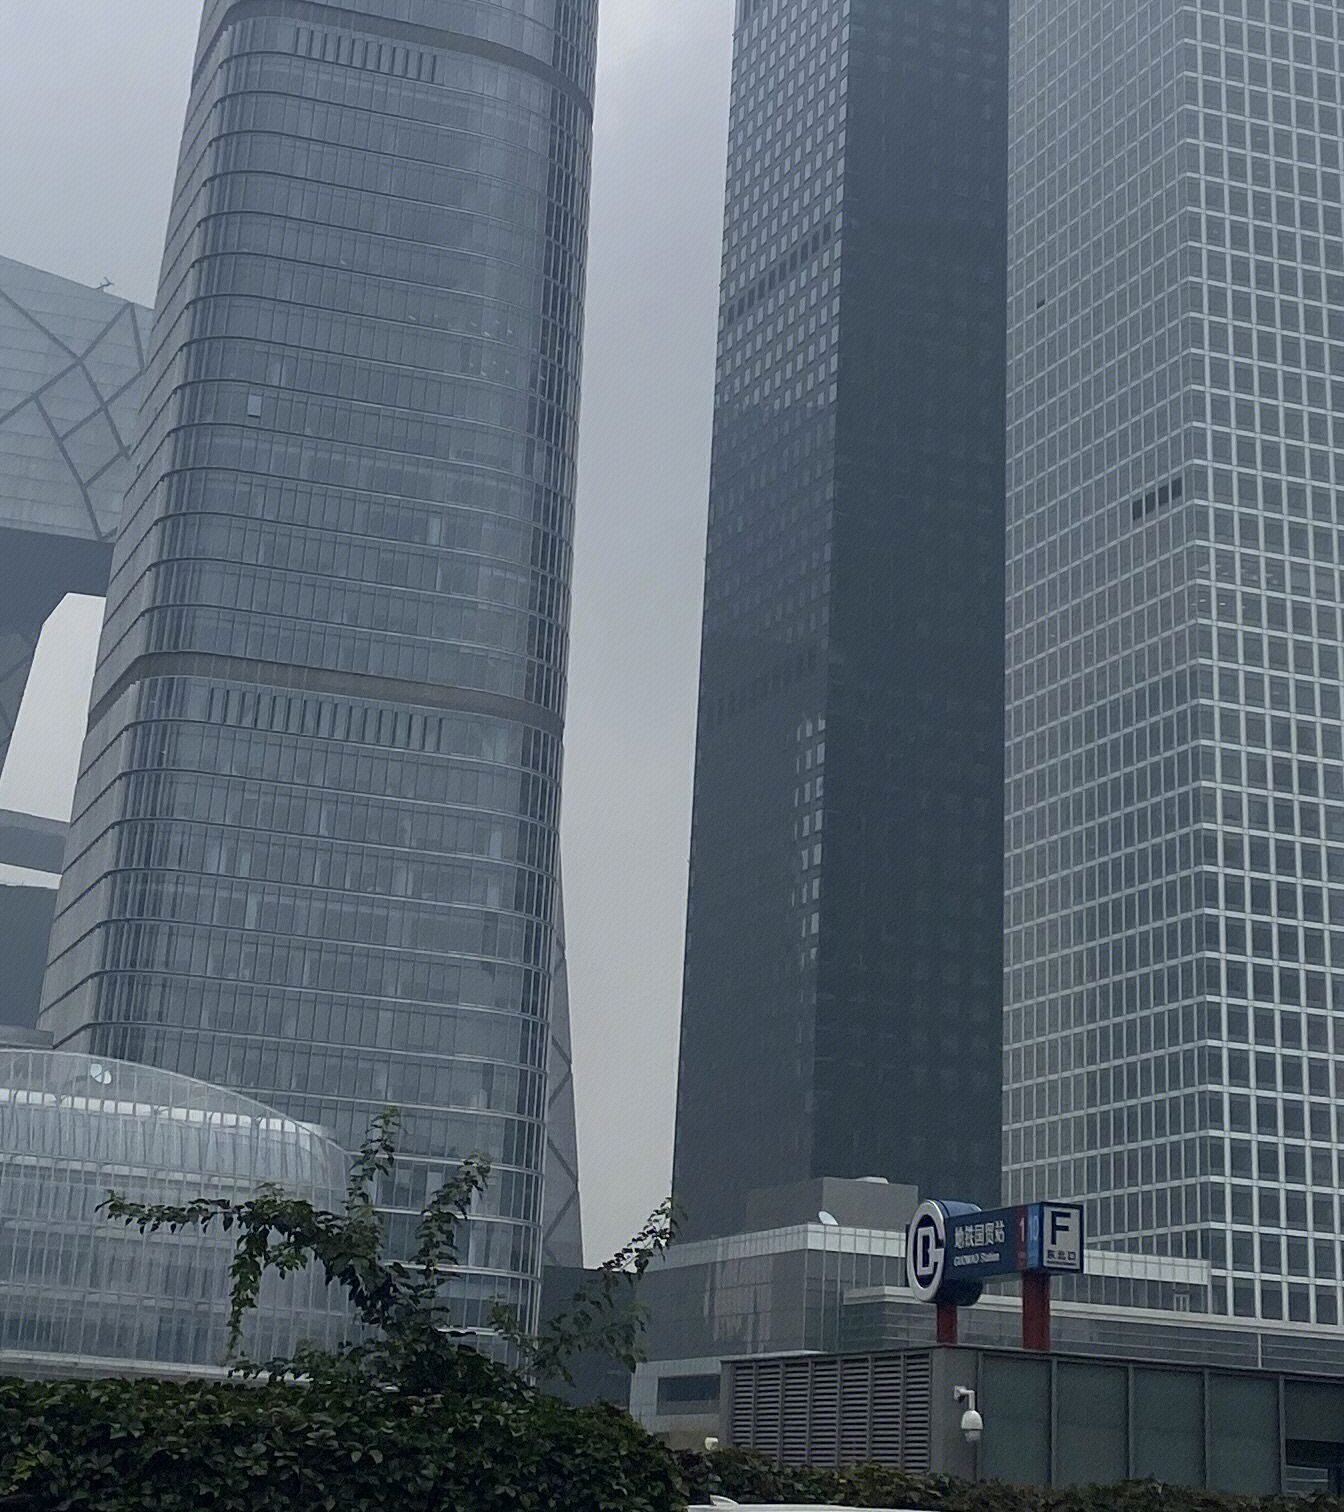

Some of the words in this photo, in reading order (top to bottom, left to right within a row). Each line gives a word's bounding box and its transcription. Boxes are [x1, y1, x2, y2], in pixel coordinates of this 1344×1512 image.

[954, 1218, 1006, 1249] 地铁国贸站
[1051, 1211, 1071, 1245] F
